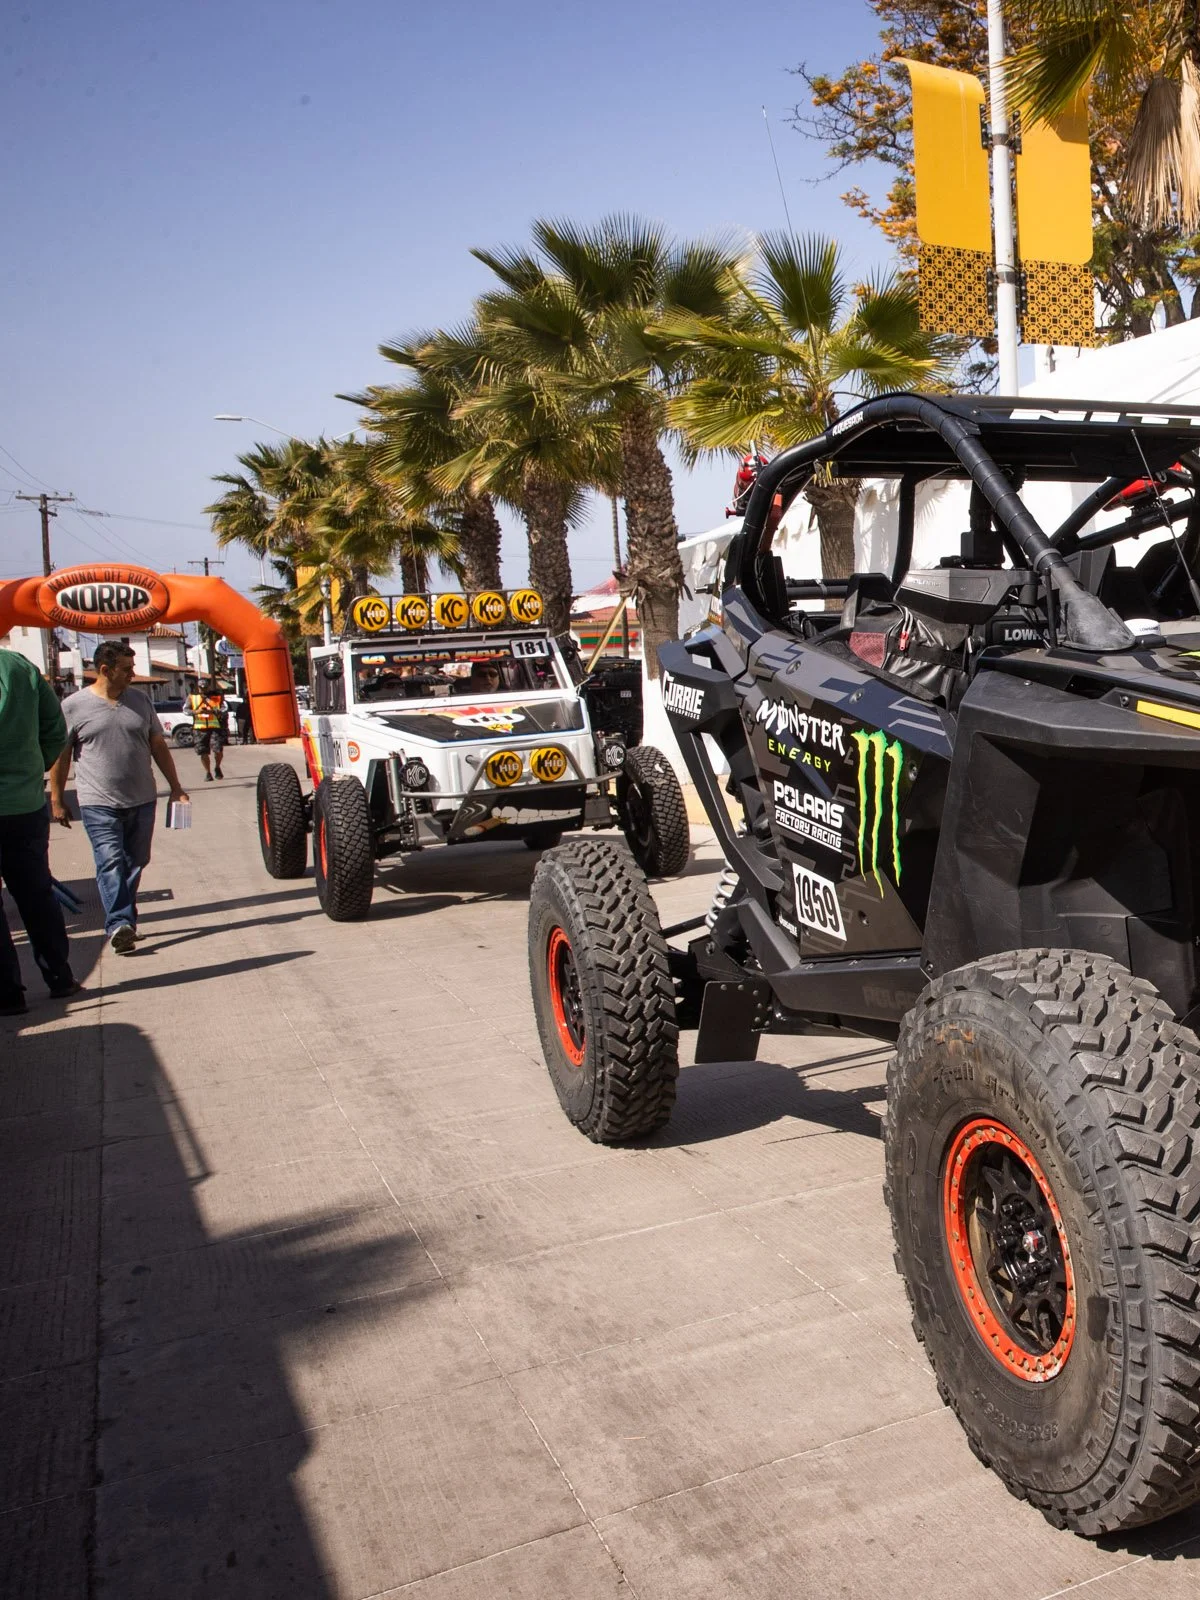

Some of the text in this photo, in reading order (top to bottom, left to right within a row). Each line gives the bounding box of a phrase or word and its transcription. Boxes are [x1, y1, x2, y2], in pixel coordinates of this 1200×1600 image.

[47, 570, 157, 591] NATIONAL OFF ROAD
[60, 584, 149, 612] NORRA
[441, 599, 463, 622] KC
[50, 606, 161, 628] RACING ASSOCIATION
[516, 640, 546, 655] 181
[663, 670, 705, 714] CURRIE
[666, 705, 701, 720] ENTERPRISES
[756, 698, 846, 757] MONSTER
[606, 745, 624, 766] KC
[768, 738, 832, 773] ENERGY
[406, 765, 427, 787] KC
[773, 780, 845, 829] POLARIS
[775, 809, 842, 849] FACTORY RACING
[796, 873, 840, 933] 1959
